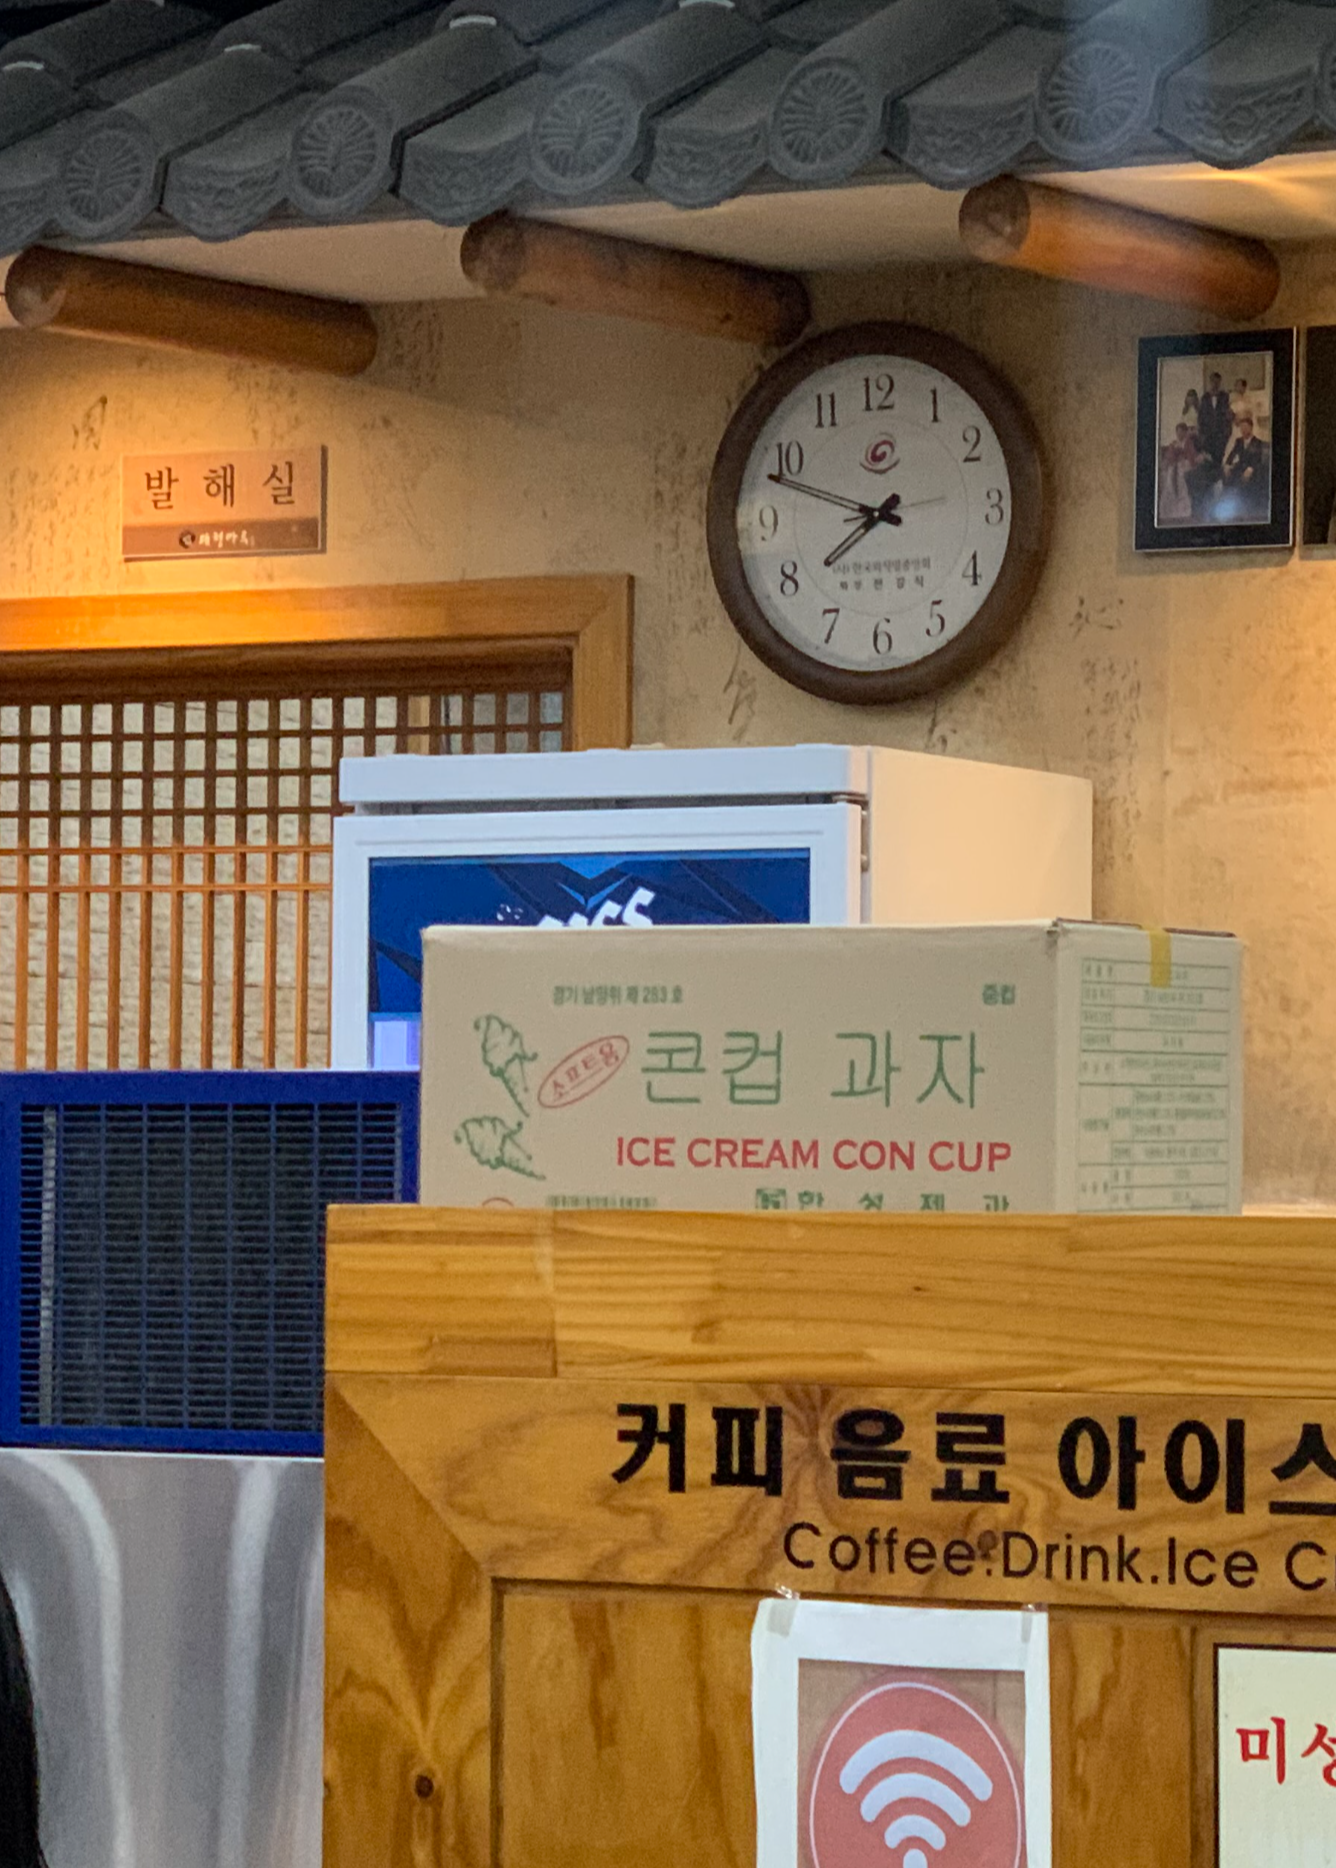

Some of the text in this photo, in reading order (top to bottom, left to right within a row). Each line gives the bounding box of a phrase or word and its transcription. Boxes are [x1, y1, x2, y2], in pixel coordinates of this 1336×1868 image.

[814, 391, 838, 428] 11
[863, 373, 895, 413] 12
[929, 386, 940, 423] 1
[775, 440, 804, 477] 10
[961, 425, 982, 463] 2
[758, 505, 779, 542] 9
[984, 488, 1004, 526] 3
[779, 560, 800, 597] 8
[961, 549, 982, 587] 4
[822, 607, 841, 645] 7
[872, 617, 893, 655] 6
[925, 599, 946, 638] 5
[641, 1029, 986, 1109] 콘컵 과자
[617, 1137, 1012, 1172] ICE CREAM CON CUP
[611, 1402, 784, 1497] 커피
[829, 1408, 1010, 1504] 음료
